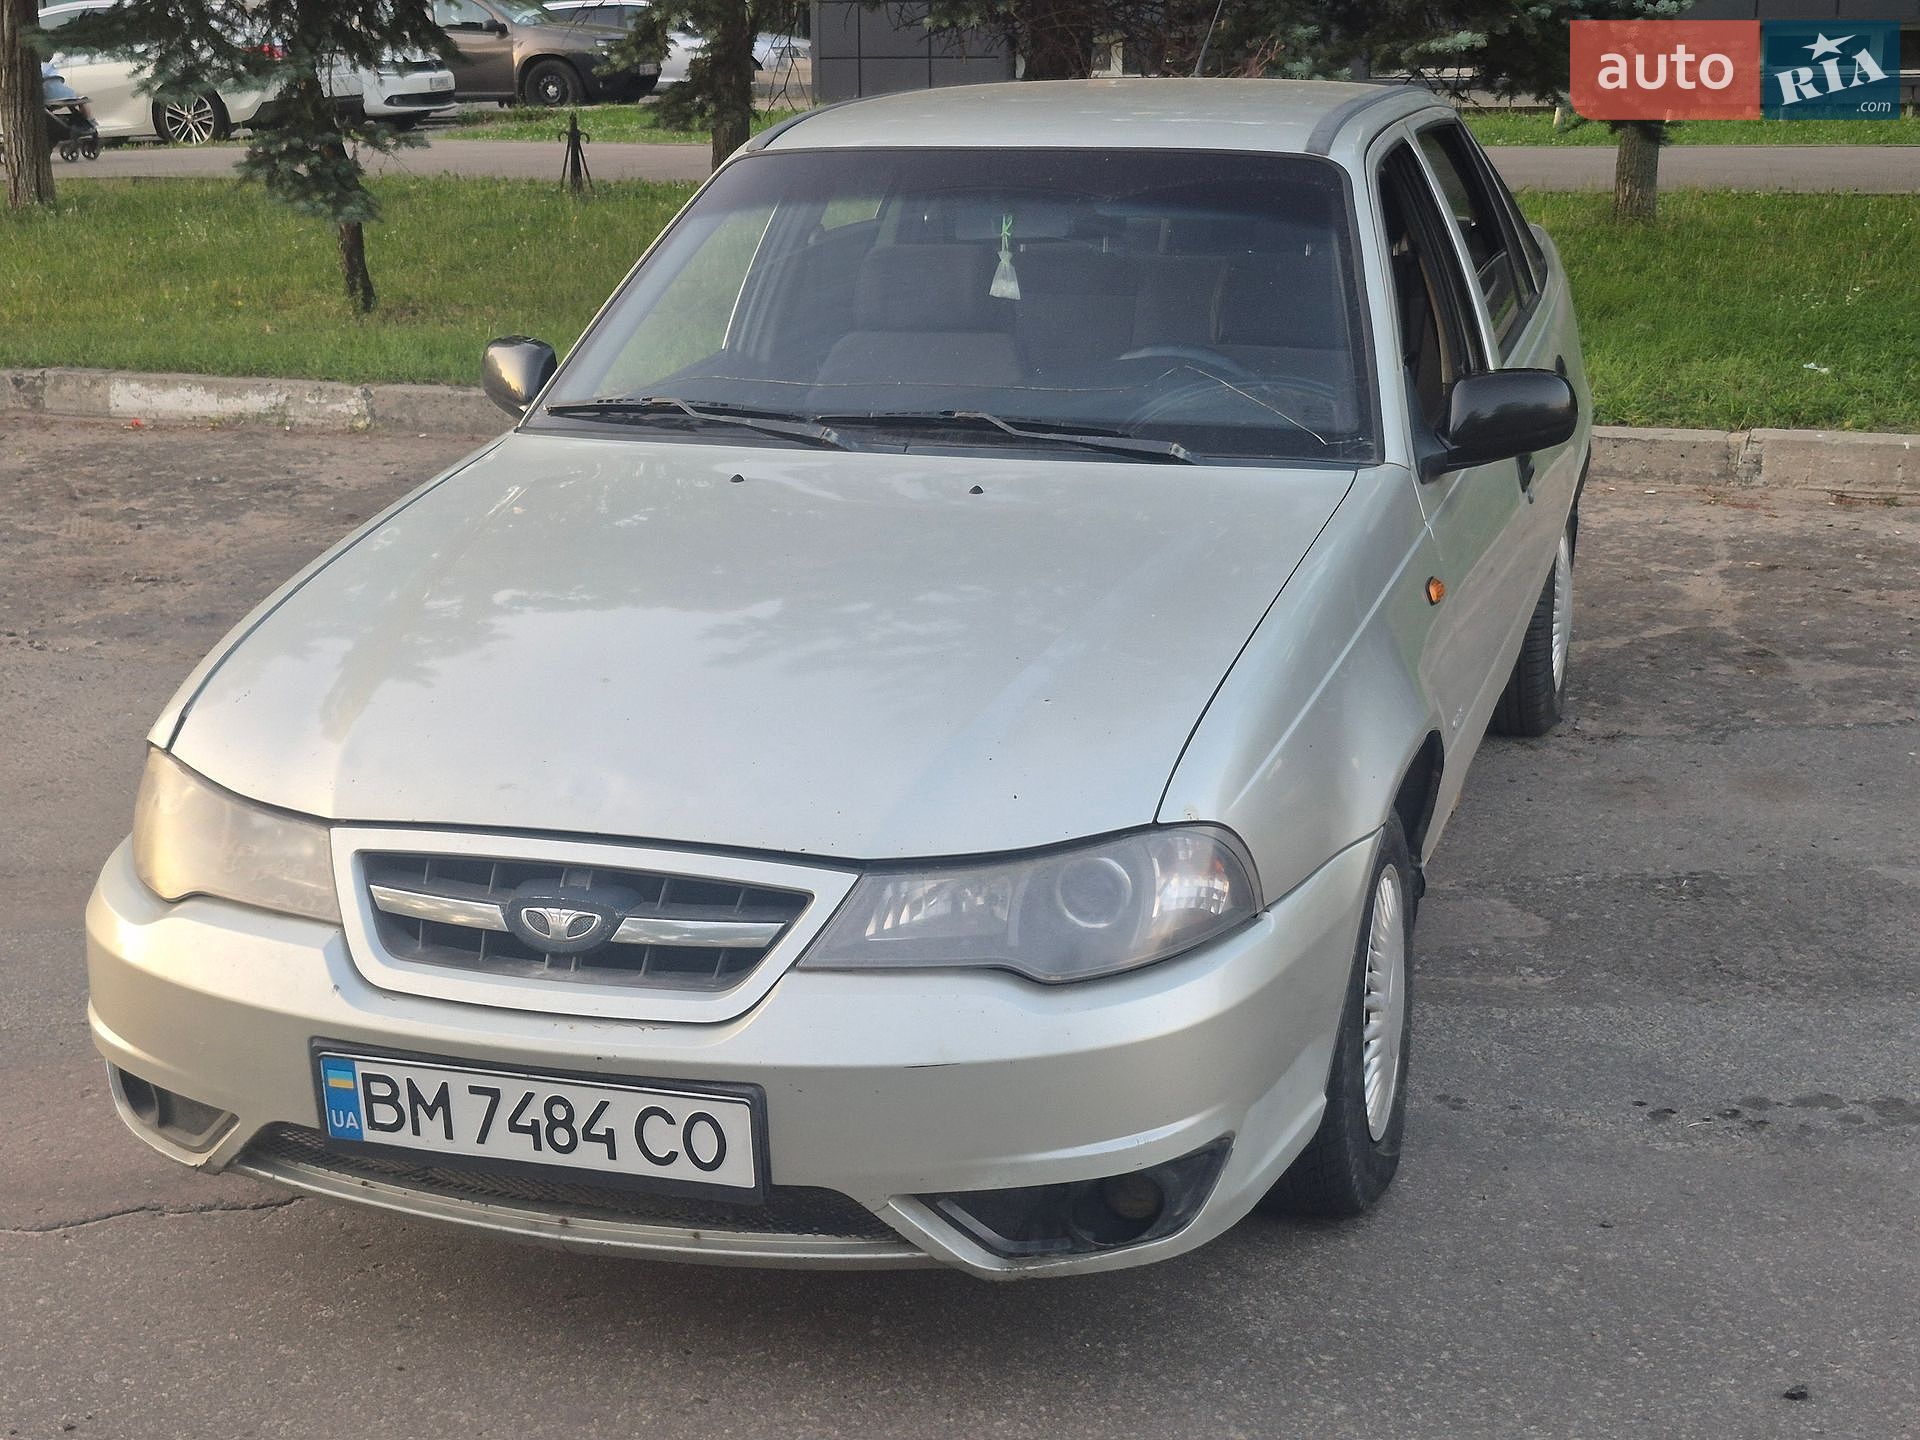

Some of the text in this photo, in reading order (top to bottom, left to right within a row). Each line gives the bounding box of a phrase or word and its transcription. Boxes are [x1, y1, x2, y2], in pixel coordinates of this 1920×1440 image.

[332, 1110, 360, 1130] UA
[361, 1072, 727, 1172] BM 7484 CO
